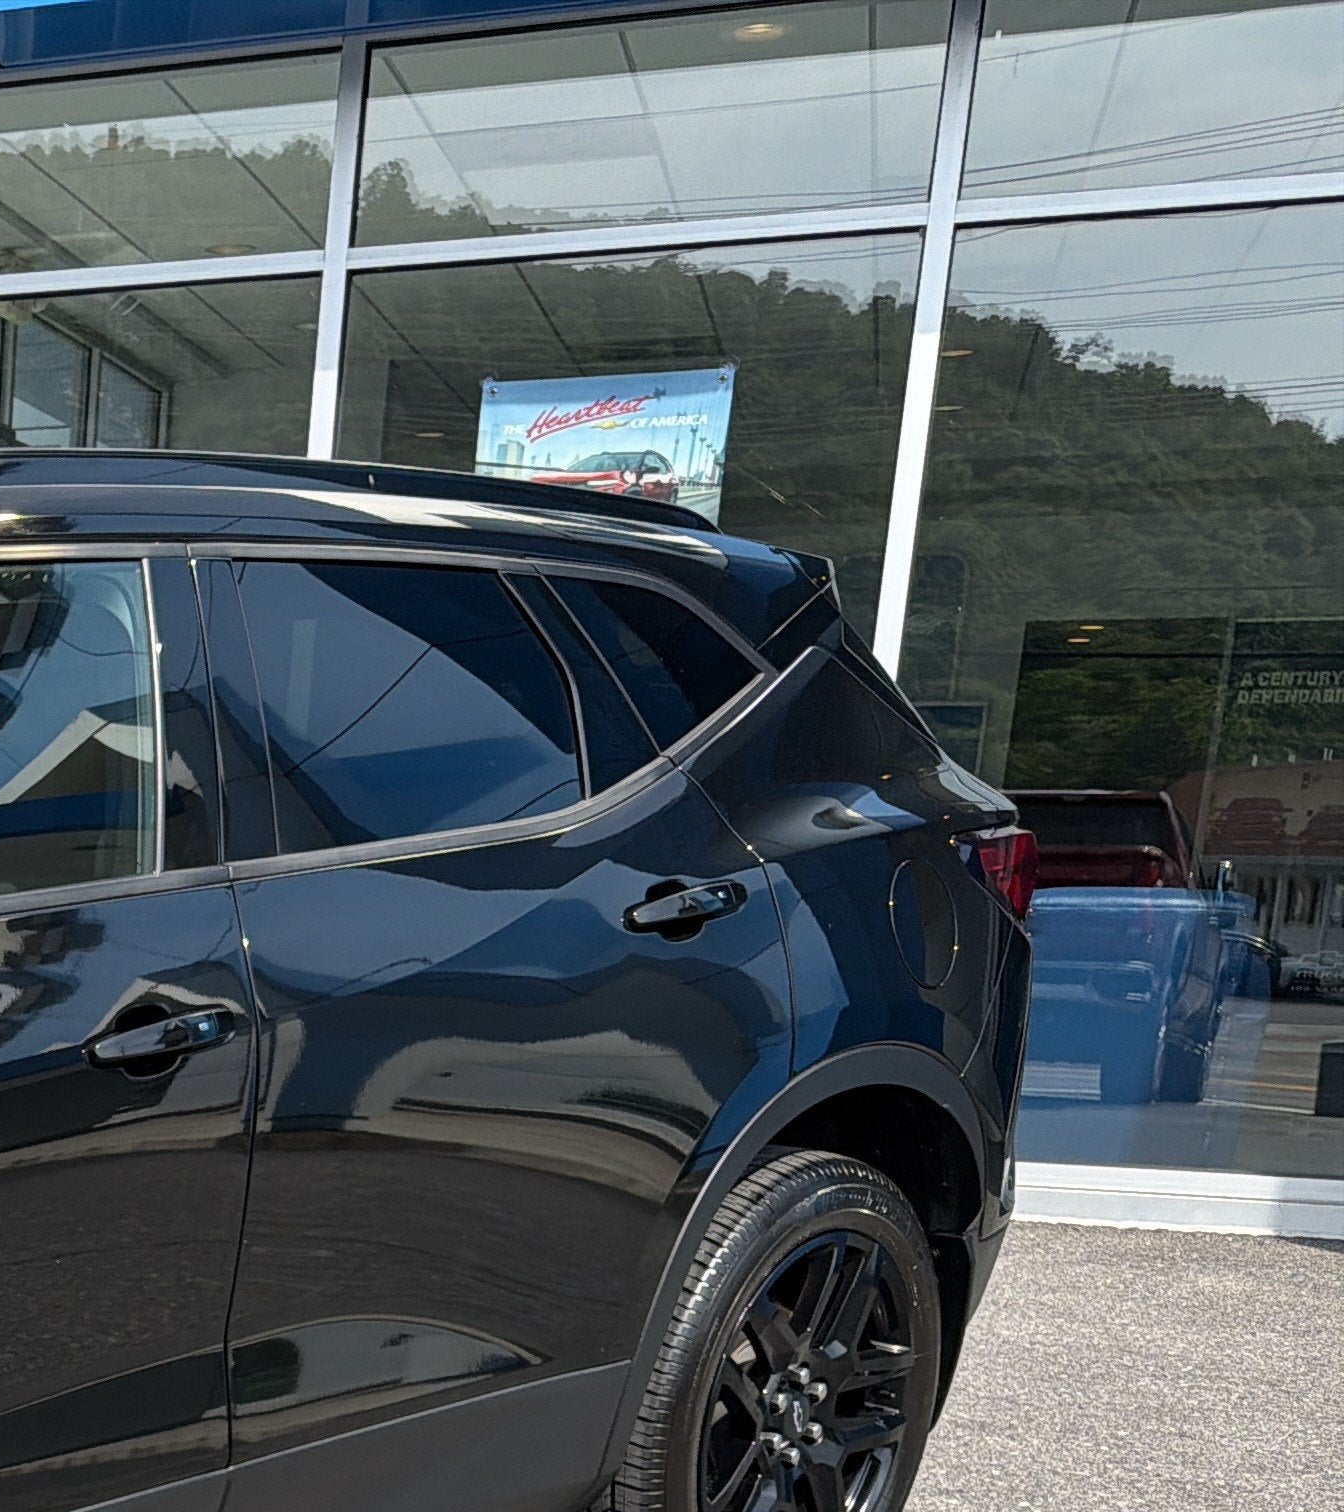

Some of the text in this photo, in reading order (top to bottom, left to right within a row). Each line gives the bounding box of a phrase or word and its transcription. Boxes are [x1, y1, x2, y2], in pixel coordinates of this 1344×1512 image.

[630, 419, 647, 429] OF
[650, 414, 709, 428] AMERICA
[1239, 671, 1344, 687] A CENTURY
